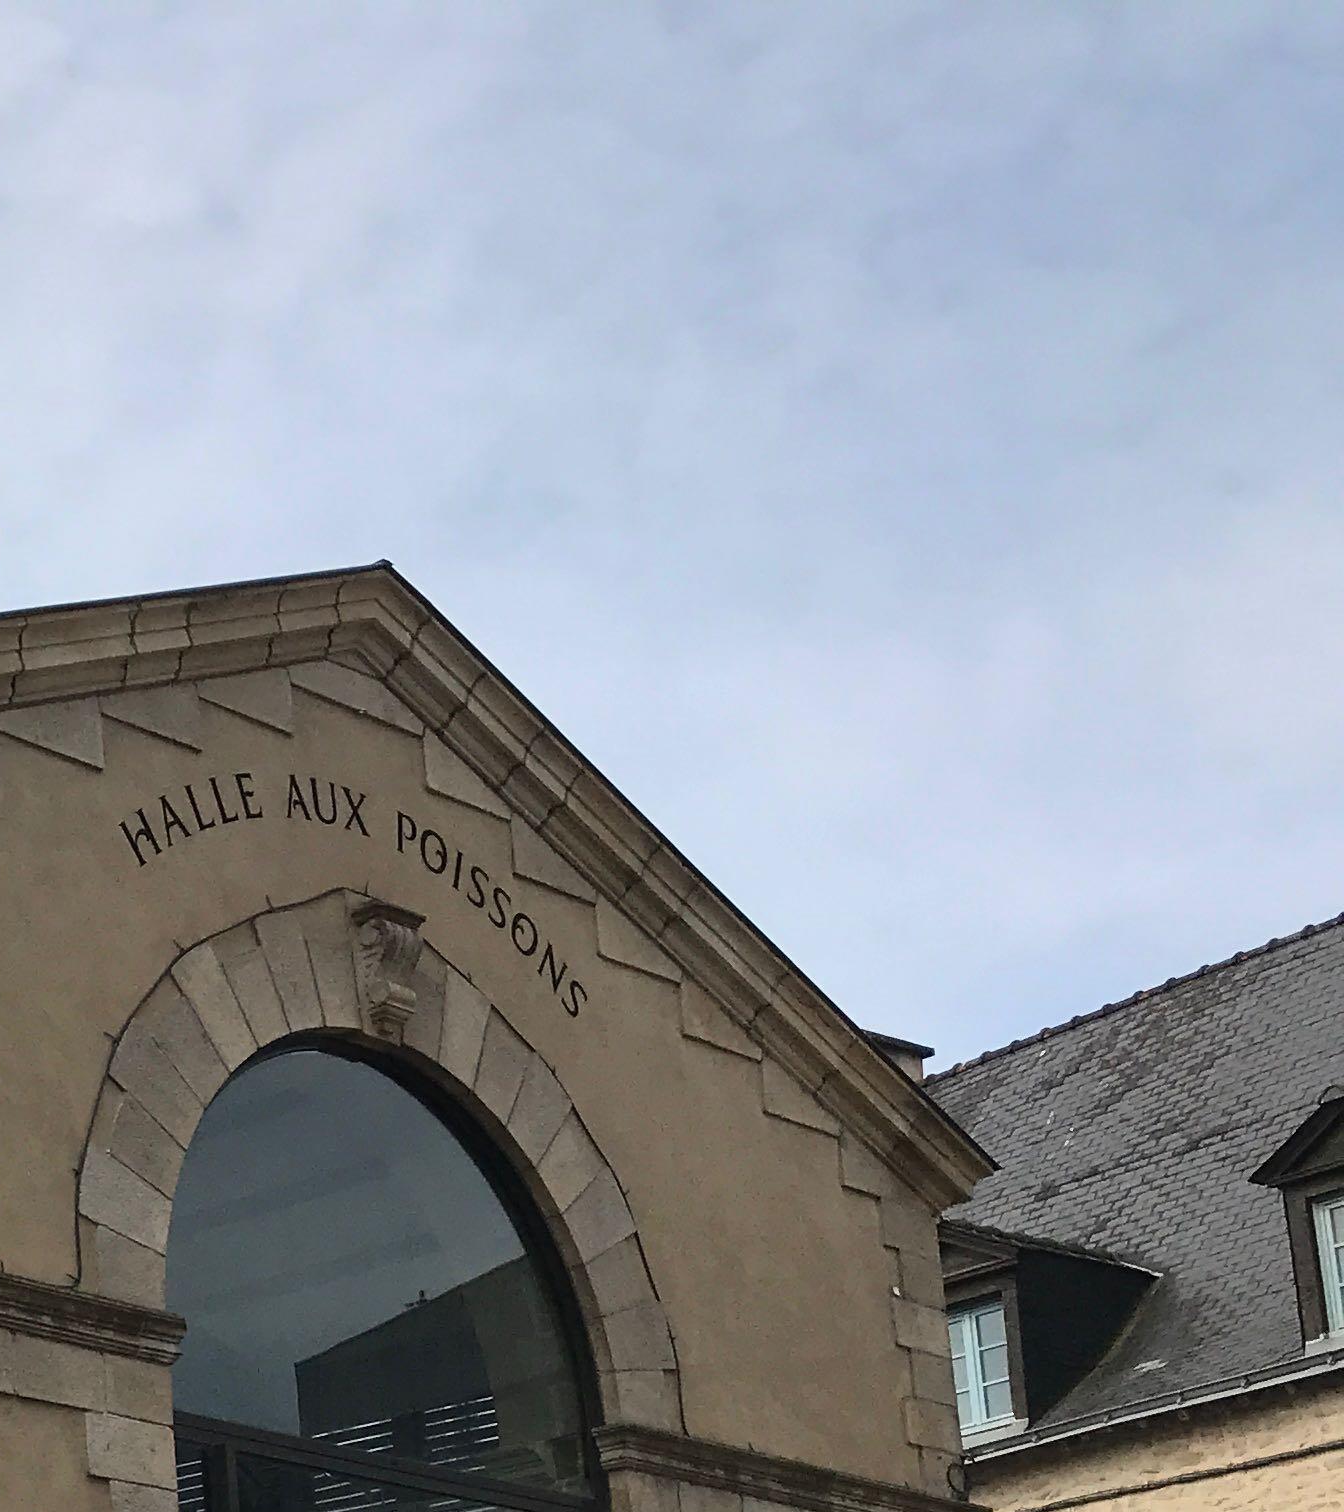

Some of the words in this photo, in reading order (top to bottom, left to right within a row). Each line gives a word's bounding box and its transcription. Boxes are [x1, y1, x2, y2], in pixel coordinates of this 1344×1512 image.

[118, 772, 263, 867] HALLE
[285, 774, 371, 838] AUX
[395, 810, 588, 1018] POISSONS
